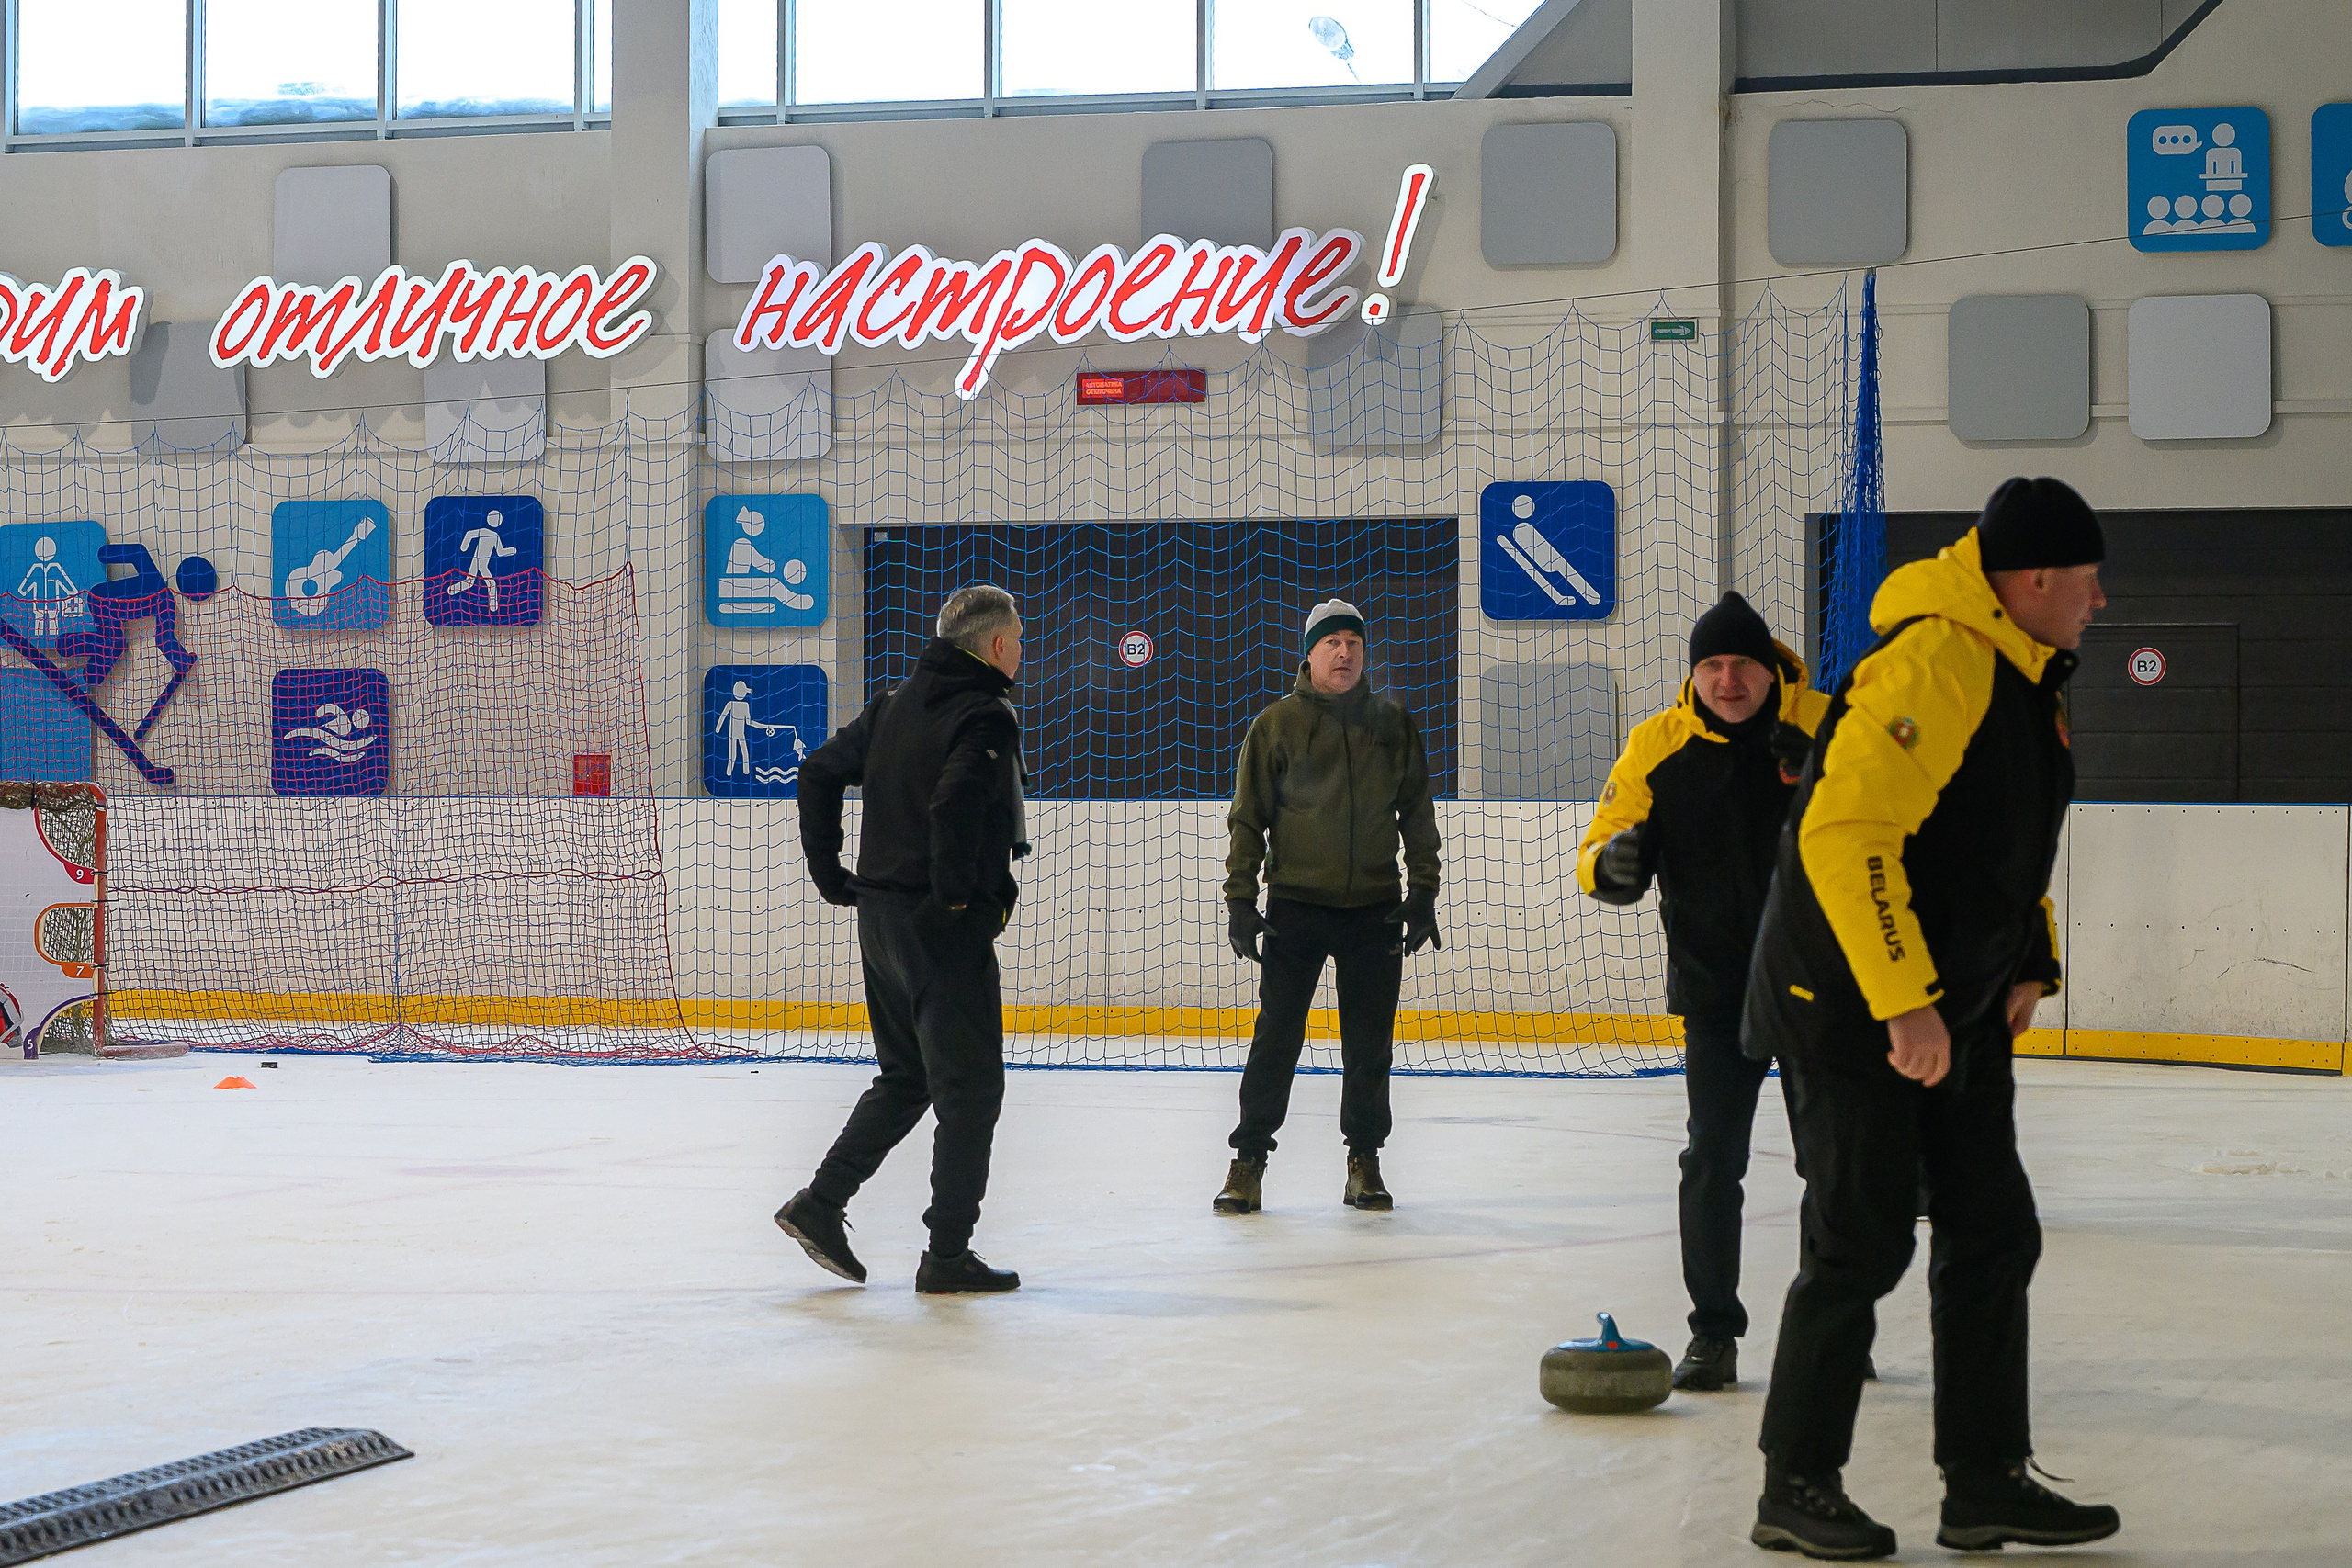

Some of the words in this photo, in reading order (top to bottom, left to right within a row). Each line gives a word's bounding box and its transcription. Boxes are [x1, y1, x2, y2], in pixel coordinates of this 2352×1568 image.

[217, 264, 650, 371] отличное
[76, 869, 84, 880] 9
[1867, 855, 1905, 962] BELARUS
[76, 965, 85, 976] 7
[27, 1039, 34, 1050] 5
